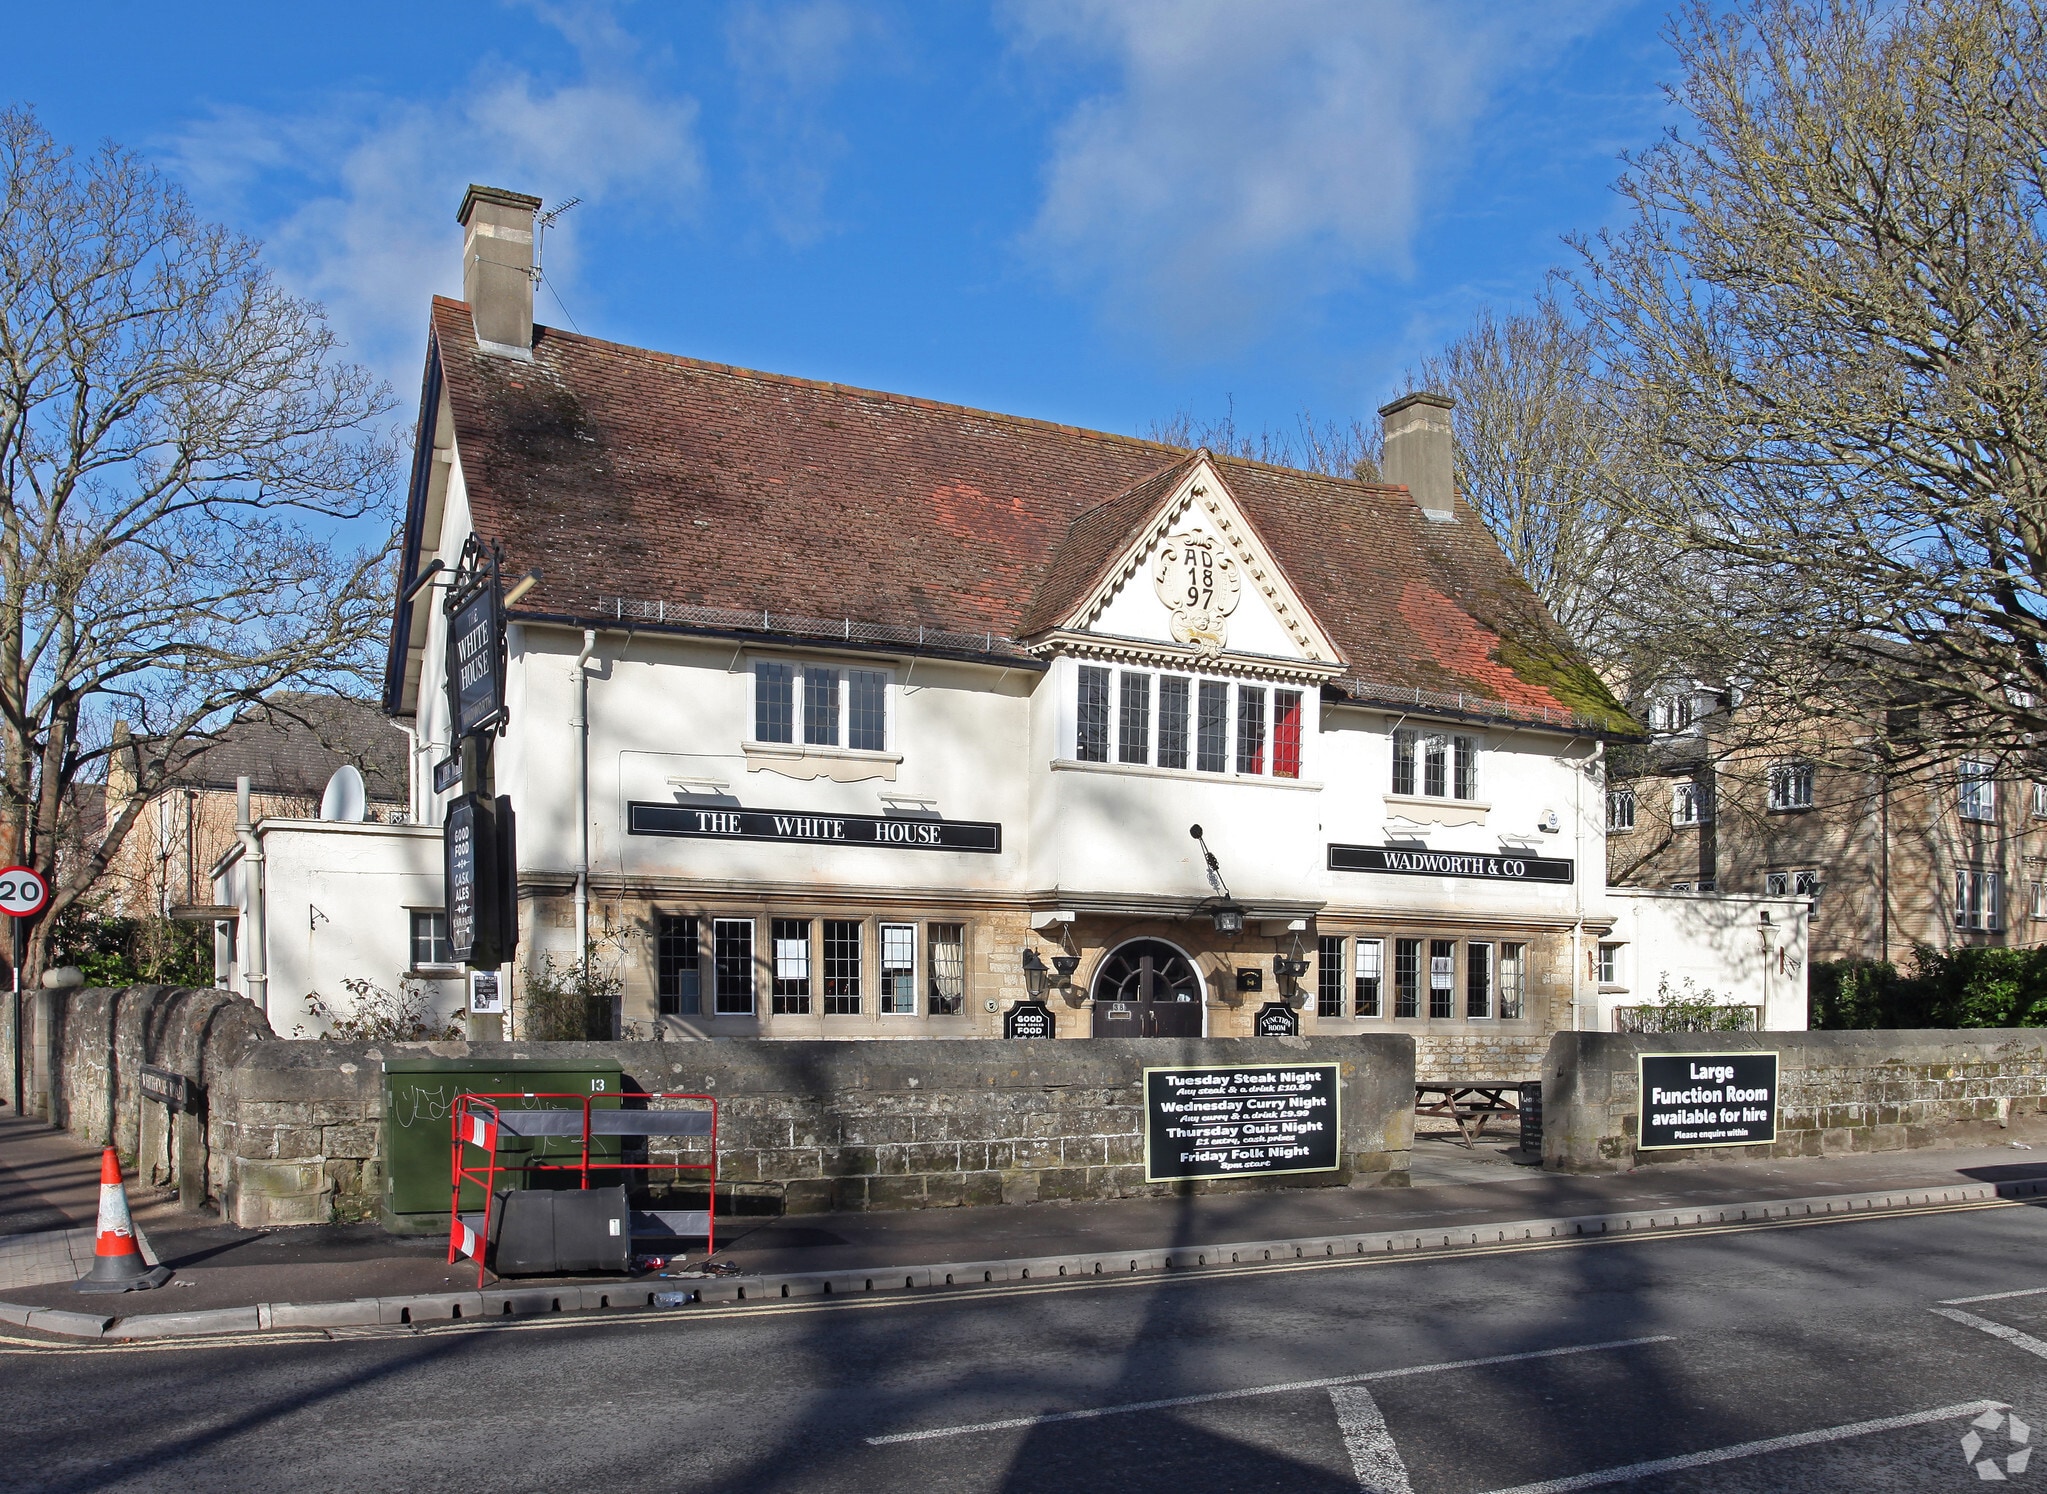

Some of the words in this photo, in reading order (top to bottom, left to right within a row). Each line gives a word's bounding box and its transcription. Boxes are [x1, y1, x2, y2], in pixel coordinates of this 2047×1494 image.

[1184, 549, 1213, 568] AD
[467, 607, 478, 627] THE
[457, 619, 489, 664] WHITE
[460, 649, 490, 692] HOUSE
[454, 825, 470, 842] GOOD
[695, 811, 742, 834] THE
[772, 816, 845, 839] WHITE
[874, 822, 942, 844] HOUSE
[454, 842, 470, 858] FOOD
[1383, 852, 1484, 874] WADWORTH
[1488, 859, 1499, 875] &
[1503, 860, 1525, 876] CO
[454, 871, 470, 887] CASK
[0, 881, 40, 901] 20
[455, 886, 470, 902] ALES
[1017, 1015, 1042, 1023] GOOD
[1262, 1015, 1294, 1028] FUNCTION
[1166, 1074, 1230, 1087] Tuesday
[1233, 1072, 1276, 1084] Steak
[1280, 1071, 1321, 1084] Night
[1690, 1062, 1734, 1083] Large
[591, 1078, 605, 1092] 13
[1176, 1087, 1196, 1096] Any
[1198, 1086, 1226, 1095] steak
[1228, 1086, 1237, 1094] &
[1248, 1084, 1275, 1093] drink
[1277, 1083, 1312, 1092] £10.99
[1652, 1086, 1723, 1105] Function
[1726, 1085, 1768, 1102] Room
[1161, 1099, 1243, 1113] Wednesday
[1246, 1098, 1286, 1110] Curry
[1289, 1096, 1327, 1109] Night
[1180, 1114, 1200, 1123] Any
[1201, 1113, 1229, 1122] curry
[1231, 1112, 1240, 1120] &
[1251, 1110, 1278, 1119] drink
[1280, 1109, 1310, 1118] £9.99
[1652, 1108, 1717, 1126] available
[1719, 1108, 1740, 1123] for
[1743, 1106, 1768, 1122] hire
[1166, 1126, 1238, 1138] Thursday
[1243, 1124, 1278, 1135] Quiz
[1282, 1121, 1323, 1134] Night
[1674, 1130, 1698, 1139] Please
[1699, 1129, 1726, 1140] enquire
[1727, 1128, 1748, 1137] within
[1195, 1138, 1209, 1146] £1
[1211, 1137, 1240, 1146] entry,
[1243, 1135, 1266, 1143] cash
[1267, 1134, 1296, 1143] prizes
[1180, 1150, 1227, 1163] Friday
[1232, 1149, 1264, 1160] Folk
[1268, 1145, 1310, 1158] Night
[1220, 1161, 1243, 1170] 8pm
[1244, 1159, 1271, 1168] start
